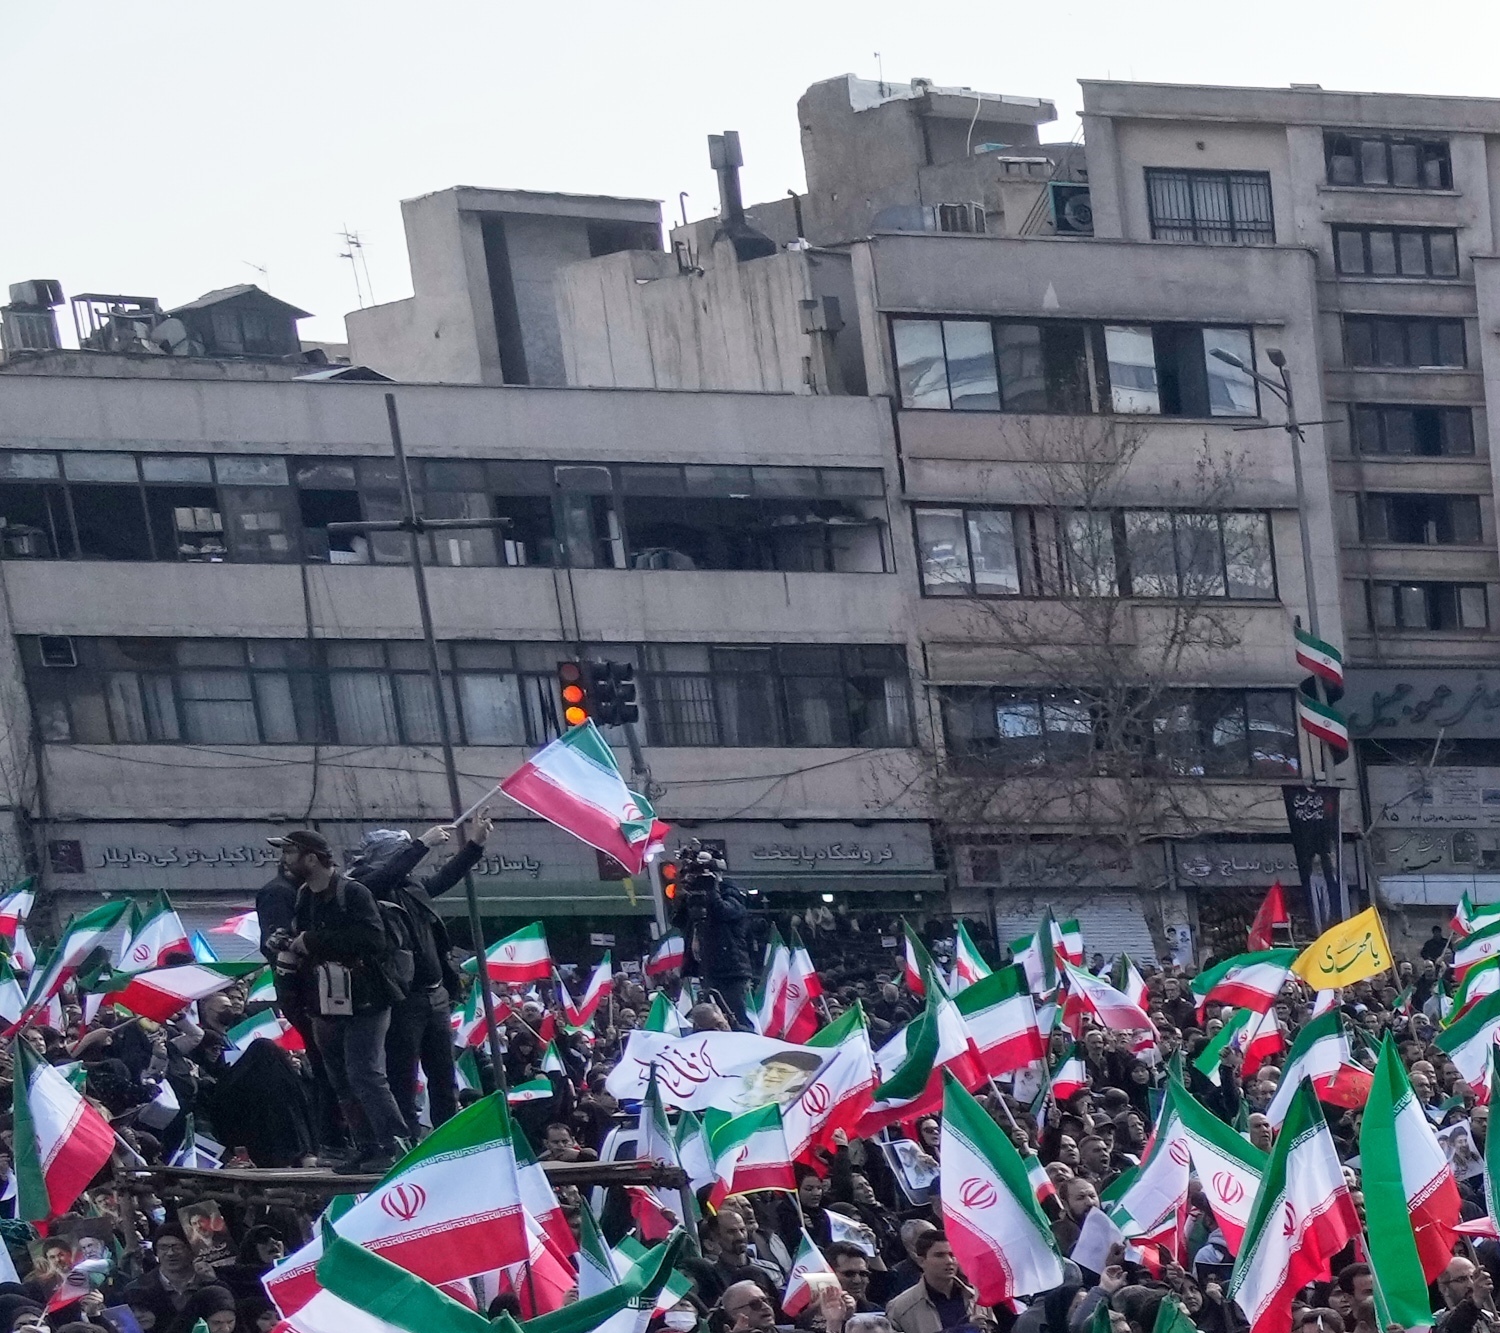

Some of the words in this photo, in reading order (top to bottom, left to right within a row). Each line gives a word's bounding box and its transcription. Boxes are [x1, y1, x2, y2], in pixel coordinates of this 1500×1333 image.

[155, 847, 197, 868] ترکی
[751, 845, 816, 868] پایتخت
[819, 841, 893, 865] فروشگاه
